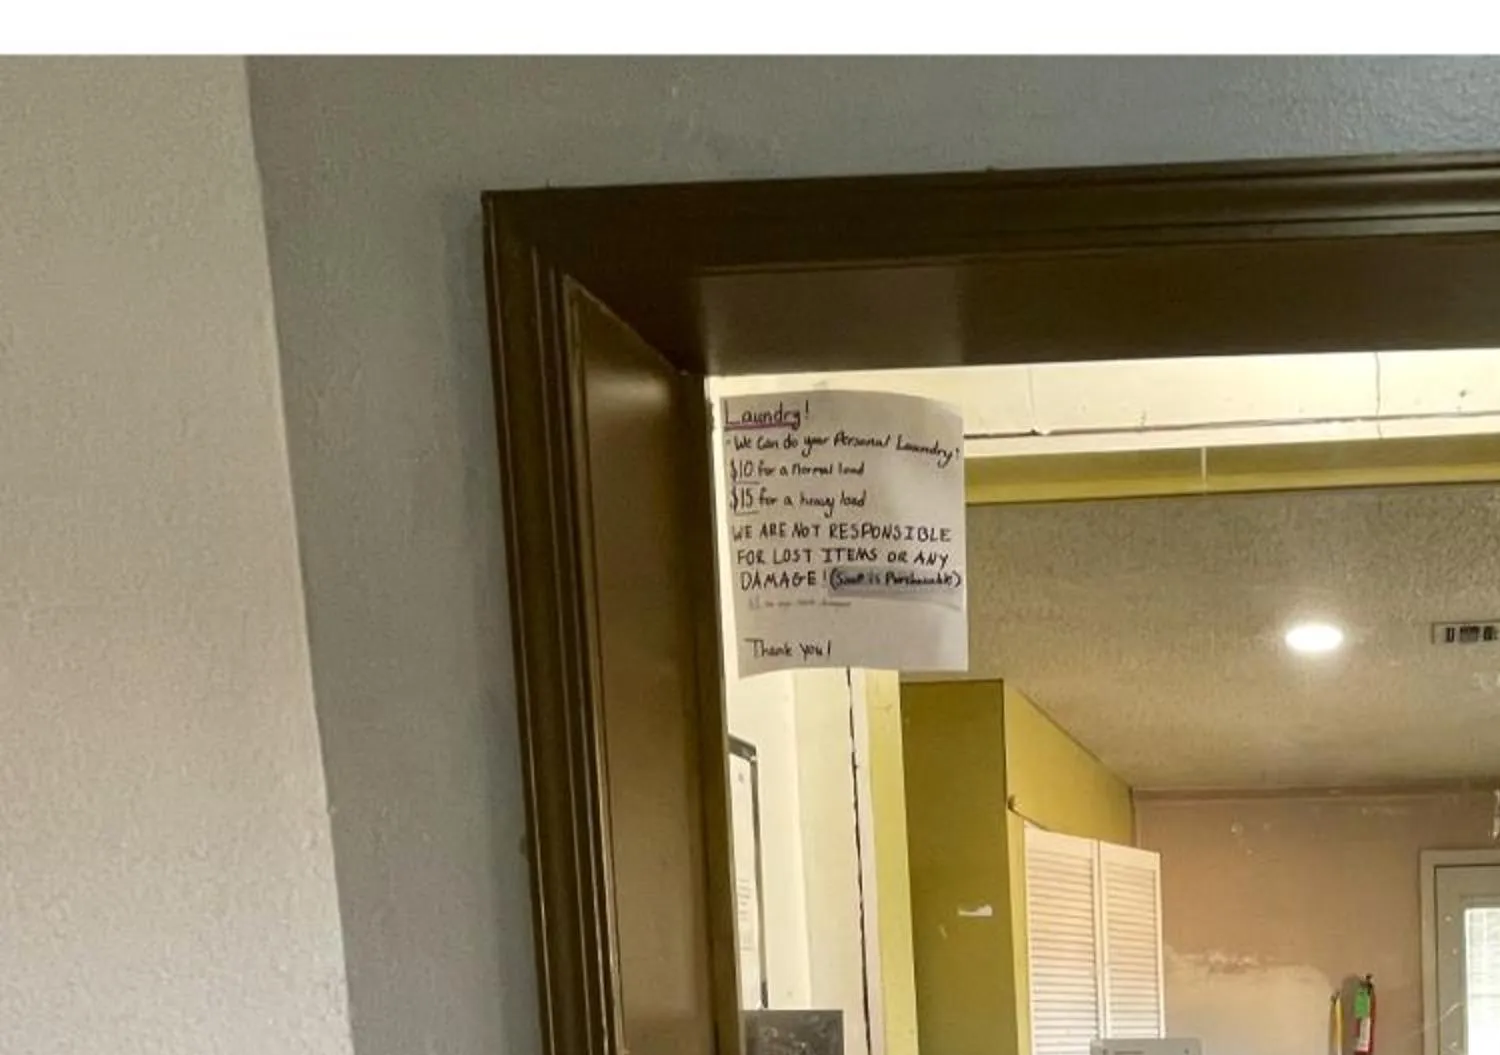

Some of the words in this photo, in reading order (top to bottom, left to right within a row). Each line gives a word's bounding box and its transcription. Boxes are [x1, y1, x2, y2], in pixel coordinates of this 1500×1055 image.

[723, 399, 809, 431] Laundry!
[783, 432, 799, 449] do
[801, 436, 830, 457] your
[730, 458, 753, 481] $10
[759, 460, 776, 476] for
[780, 465, 789, 476] a
[838, 461, 865, 477] load
[730, 486, 753, 513] $15
[759, 487, 778, 505] for
[783, 496, 793, 506] a
[800, 491, 835, 518] heavy
[840, 489, 866, 507] load
[732, 523, 752, 541] WE
[760, 521, 787, 538] ARE
[829, 522, 951, 542] RESPONSIBLE
[737, 549, 765, 566] FOR
[773, 549, 811, 565] LOST
[821, 547, 878, 564] ITEMS
[887, 549, 907, 563] OR
[913, 549, 948, 569] ANY
[744, 637, 793, 659] Thank
